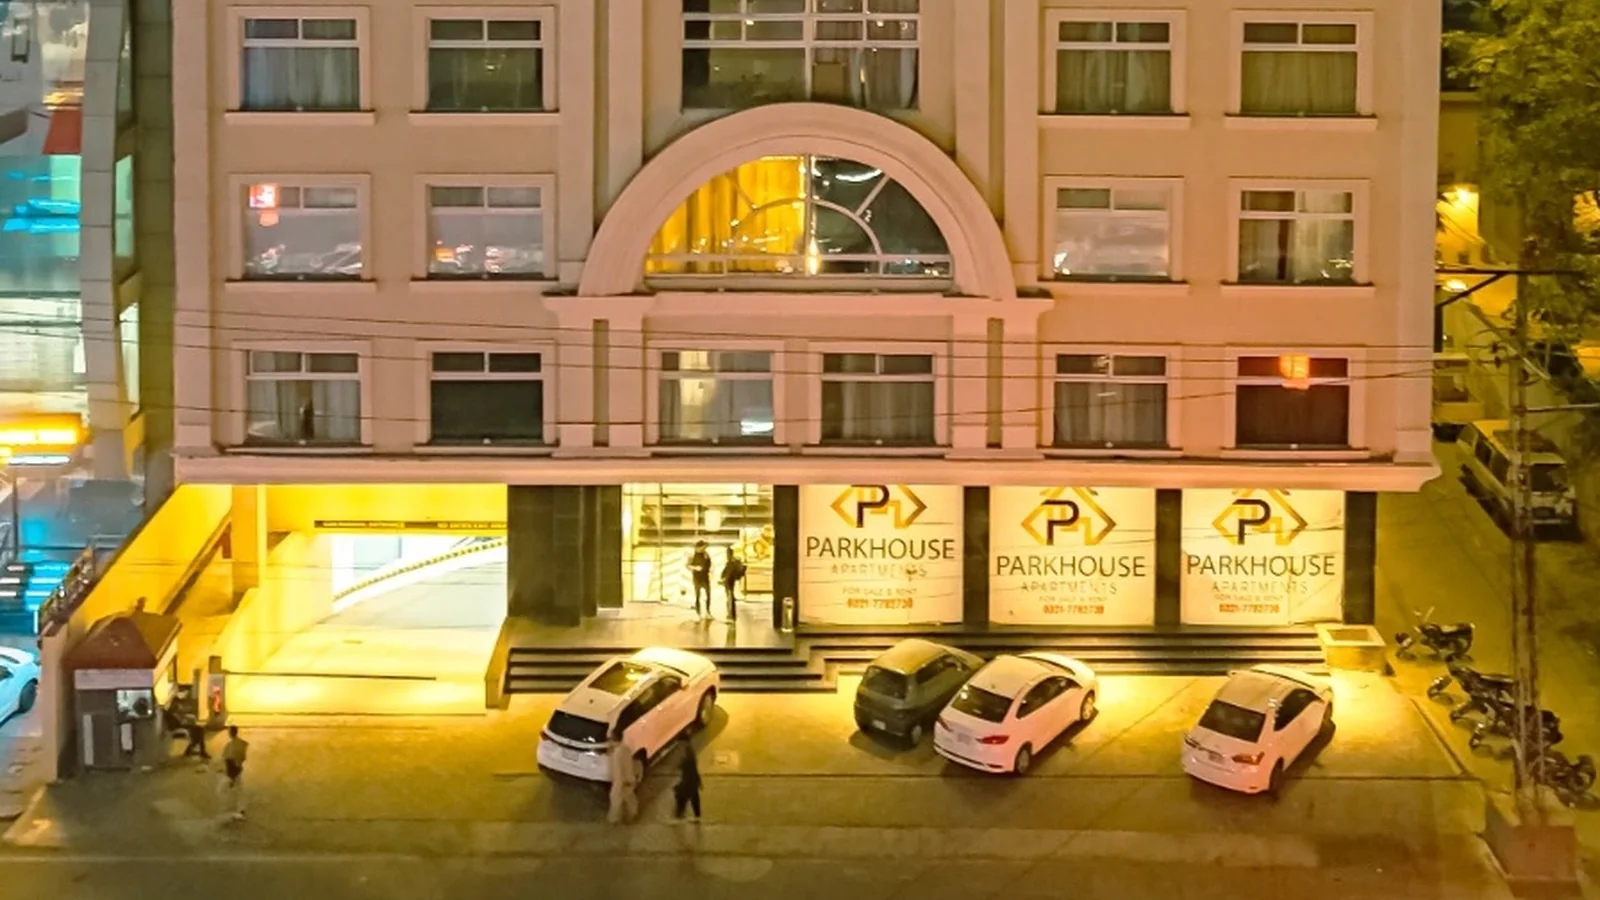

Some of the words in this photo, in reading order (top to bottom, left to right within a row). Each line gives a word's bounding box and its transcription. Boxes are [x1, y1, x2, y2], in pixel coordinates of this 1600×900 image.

[806, 536, 956, 560] PARKHOUSE
[996, 555, 1146, 578] PARKHOUSE
[1186, 554, 1336, 577] PARKHOUSE
[1021, 581, 1117, 595] APARTMENTS
[1211, 580, 1309, 595] APARTMENTS
